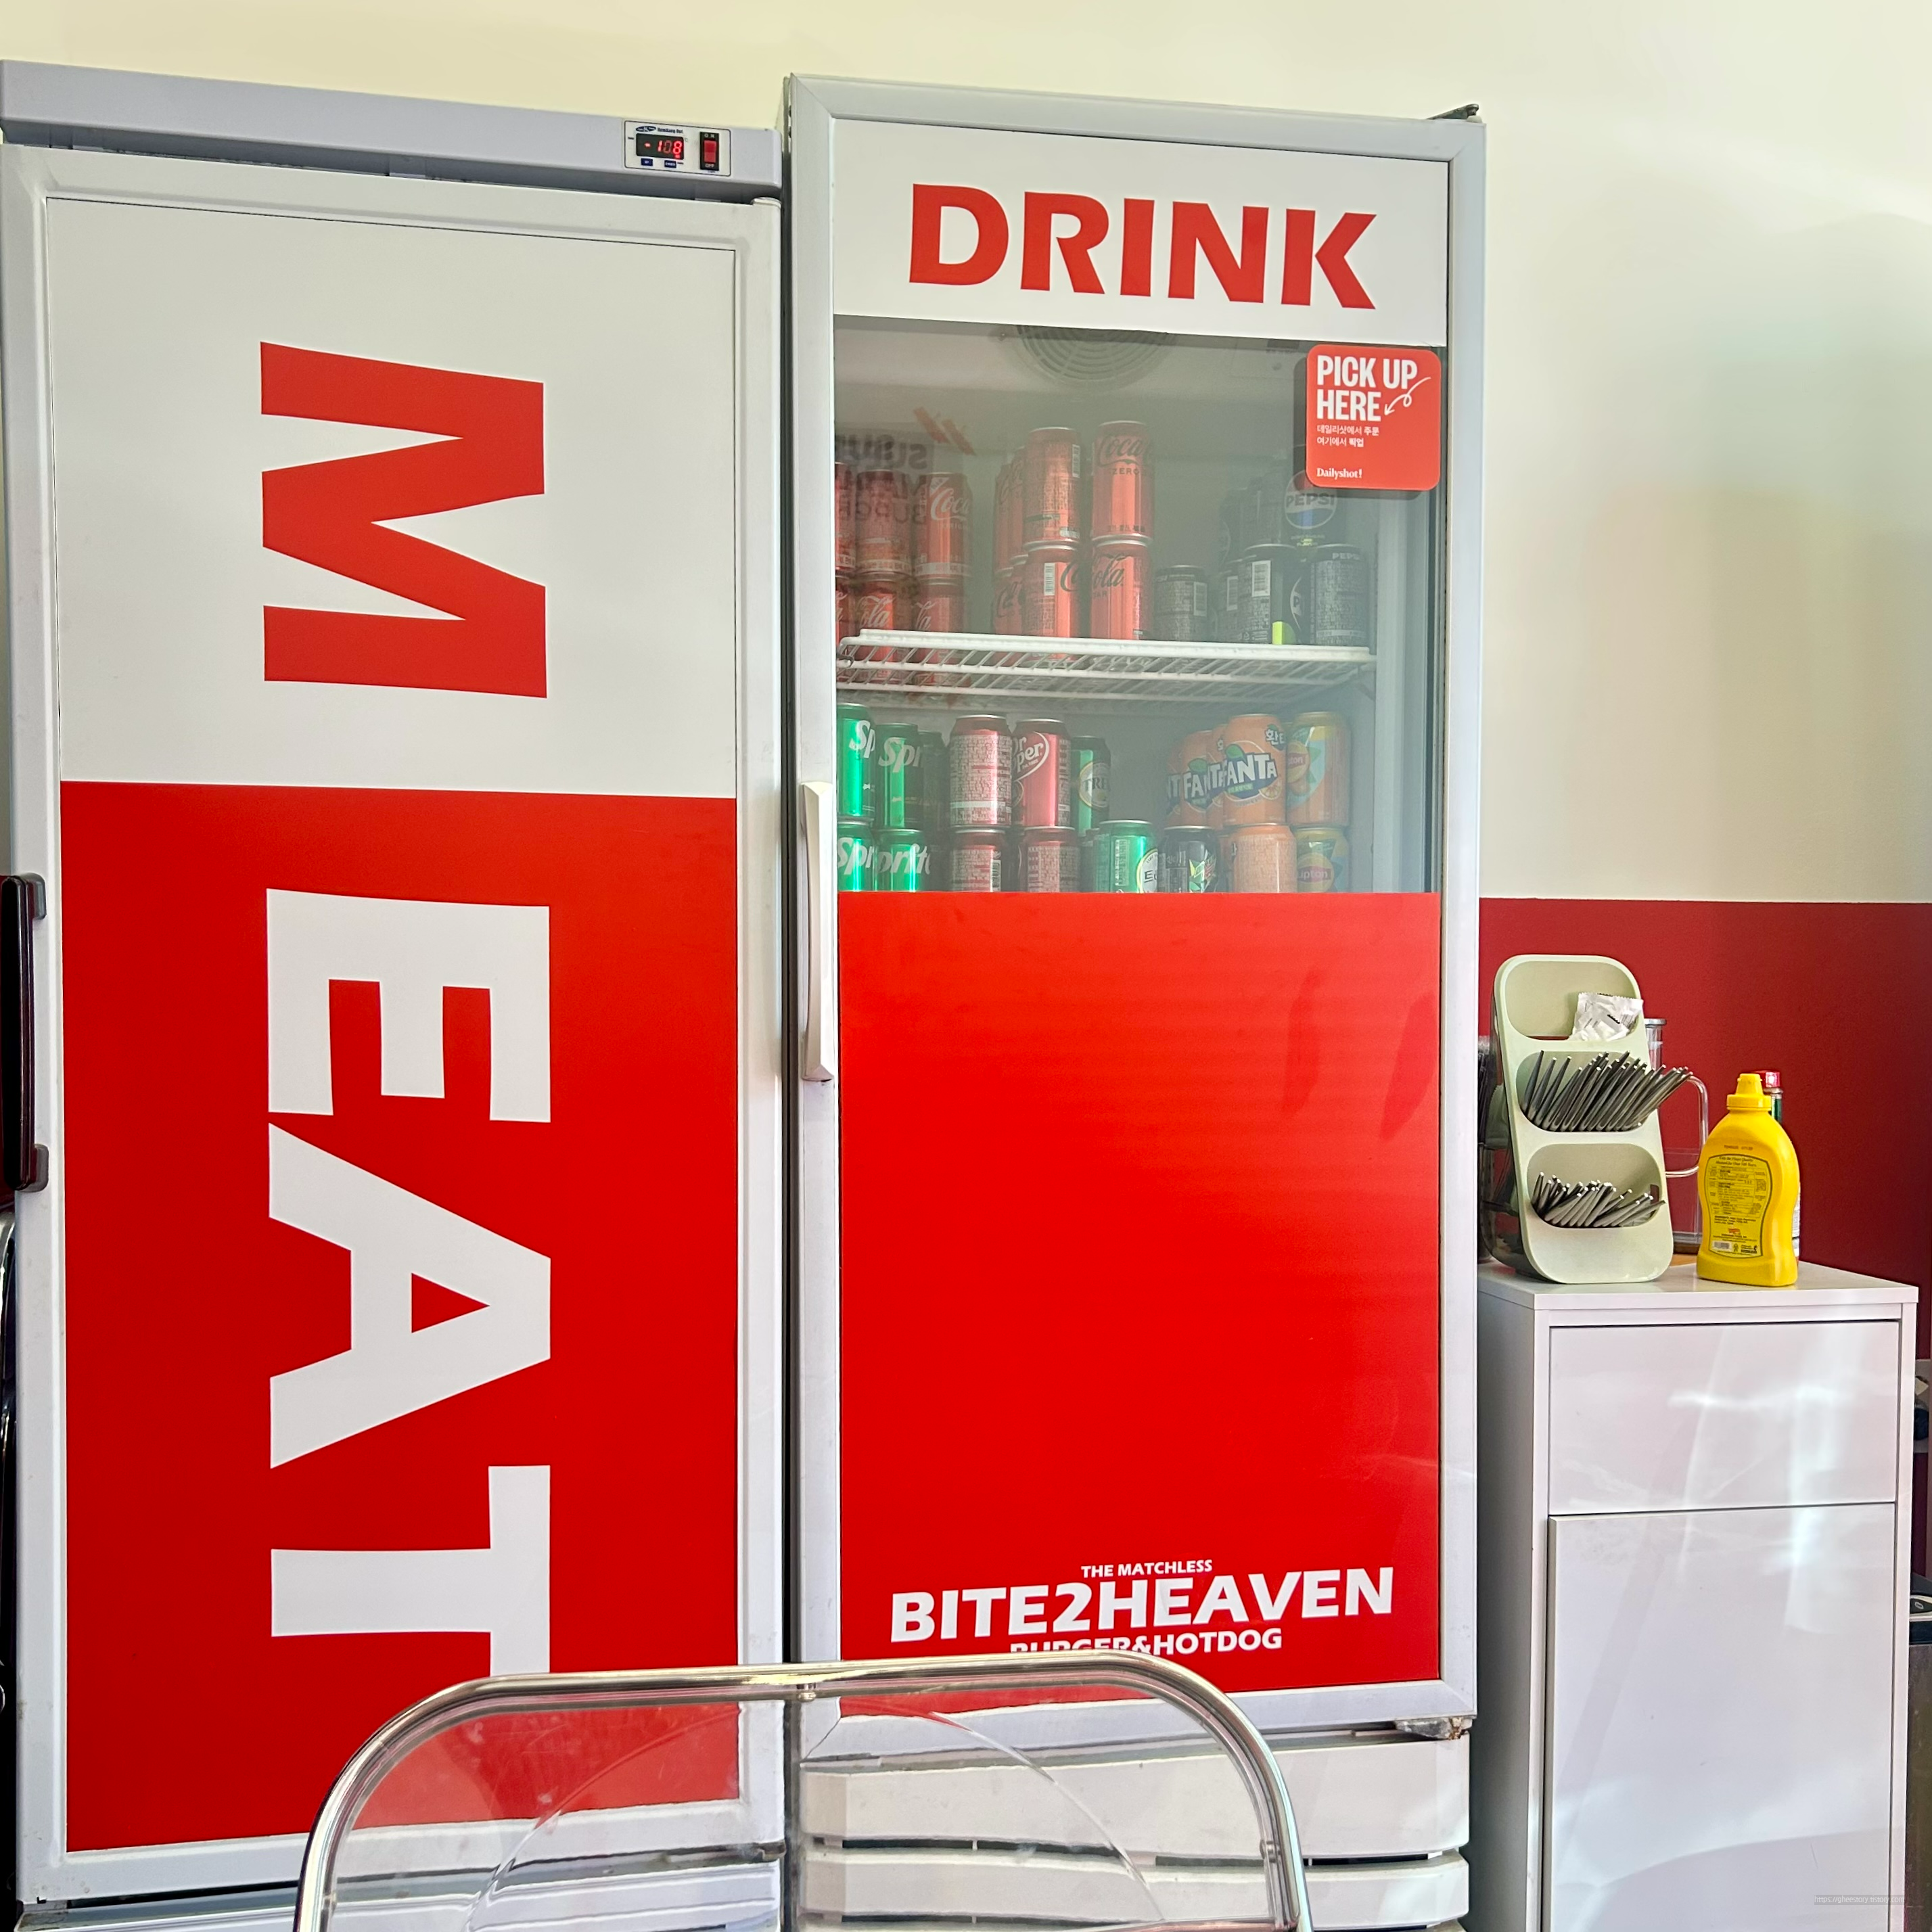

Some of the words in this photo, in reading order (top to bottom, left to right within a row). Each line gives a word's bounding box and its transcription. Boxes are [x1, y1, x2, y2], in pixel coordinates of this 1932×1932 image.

[909, 184, 1377, 310] DRINK
[1317, 355, 1377, 388] PICK
[1383, 359, 1418, 390] UP
[1317, 389, 1381, 421] HERE
[1316, 437, 1348, 446] 여기에서
[1364, 426, 1380, 436] 주문
[1316, 467, 1362, 480] Dailyshot!
[1286, 492, 1335, 508] PEPSI
[1222, 754, 1278, 787] FANTA
[260, 341, 551, 1678] MEAT
[1081, 1564, 1113, 1578] THE
[1118, 1559, 1212, 1576] MATCHLESS
[890, 1567, 1394, 1643] BITE2HEAVEN
